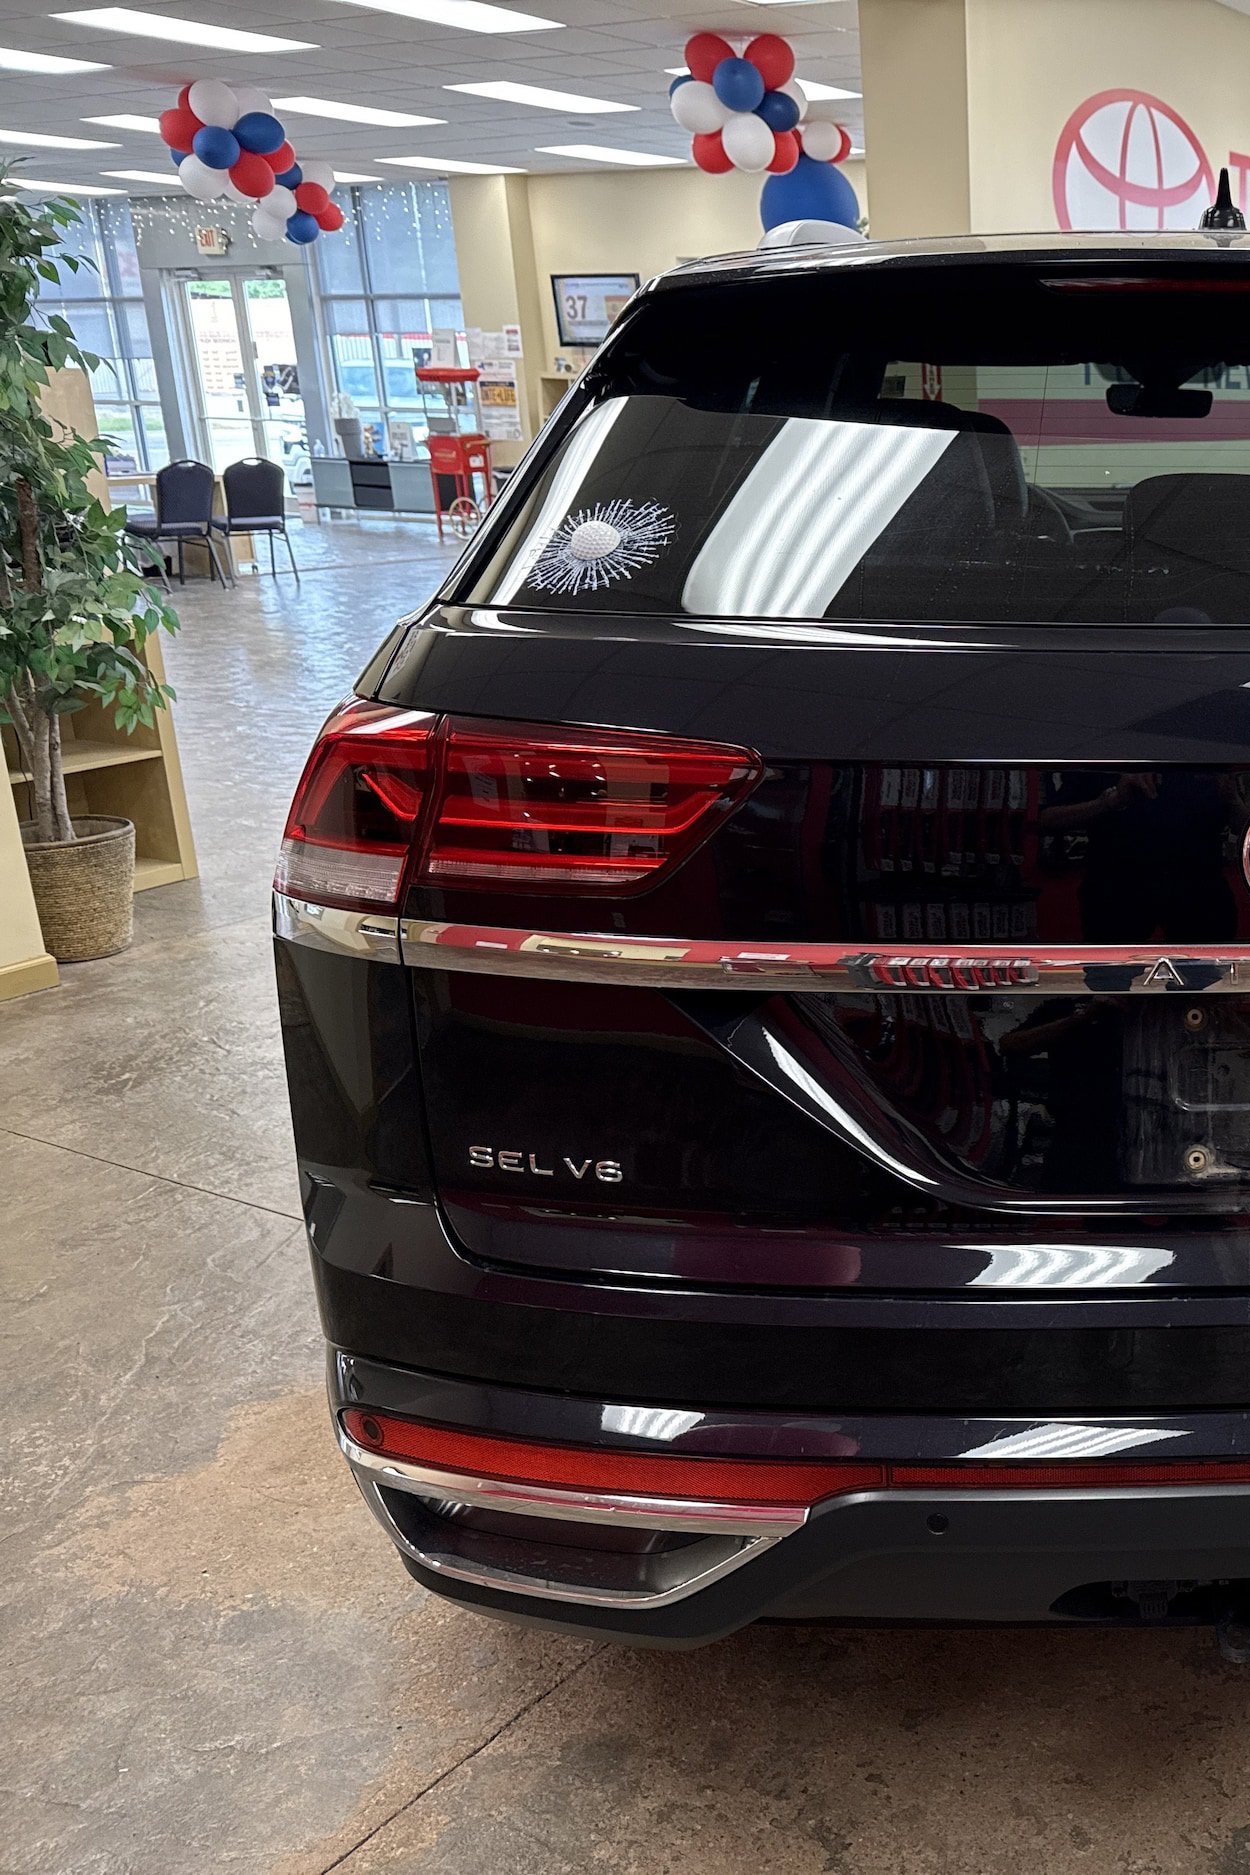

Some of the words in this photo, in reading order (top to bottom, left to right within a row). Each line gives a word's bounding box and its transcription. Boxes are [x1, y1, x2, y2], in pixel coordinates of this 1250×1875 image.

[565, 295, 588, 320] 37
[468, 1146, 554, 1176] SEL
[563, 1158, 623, 1183] V6
